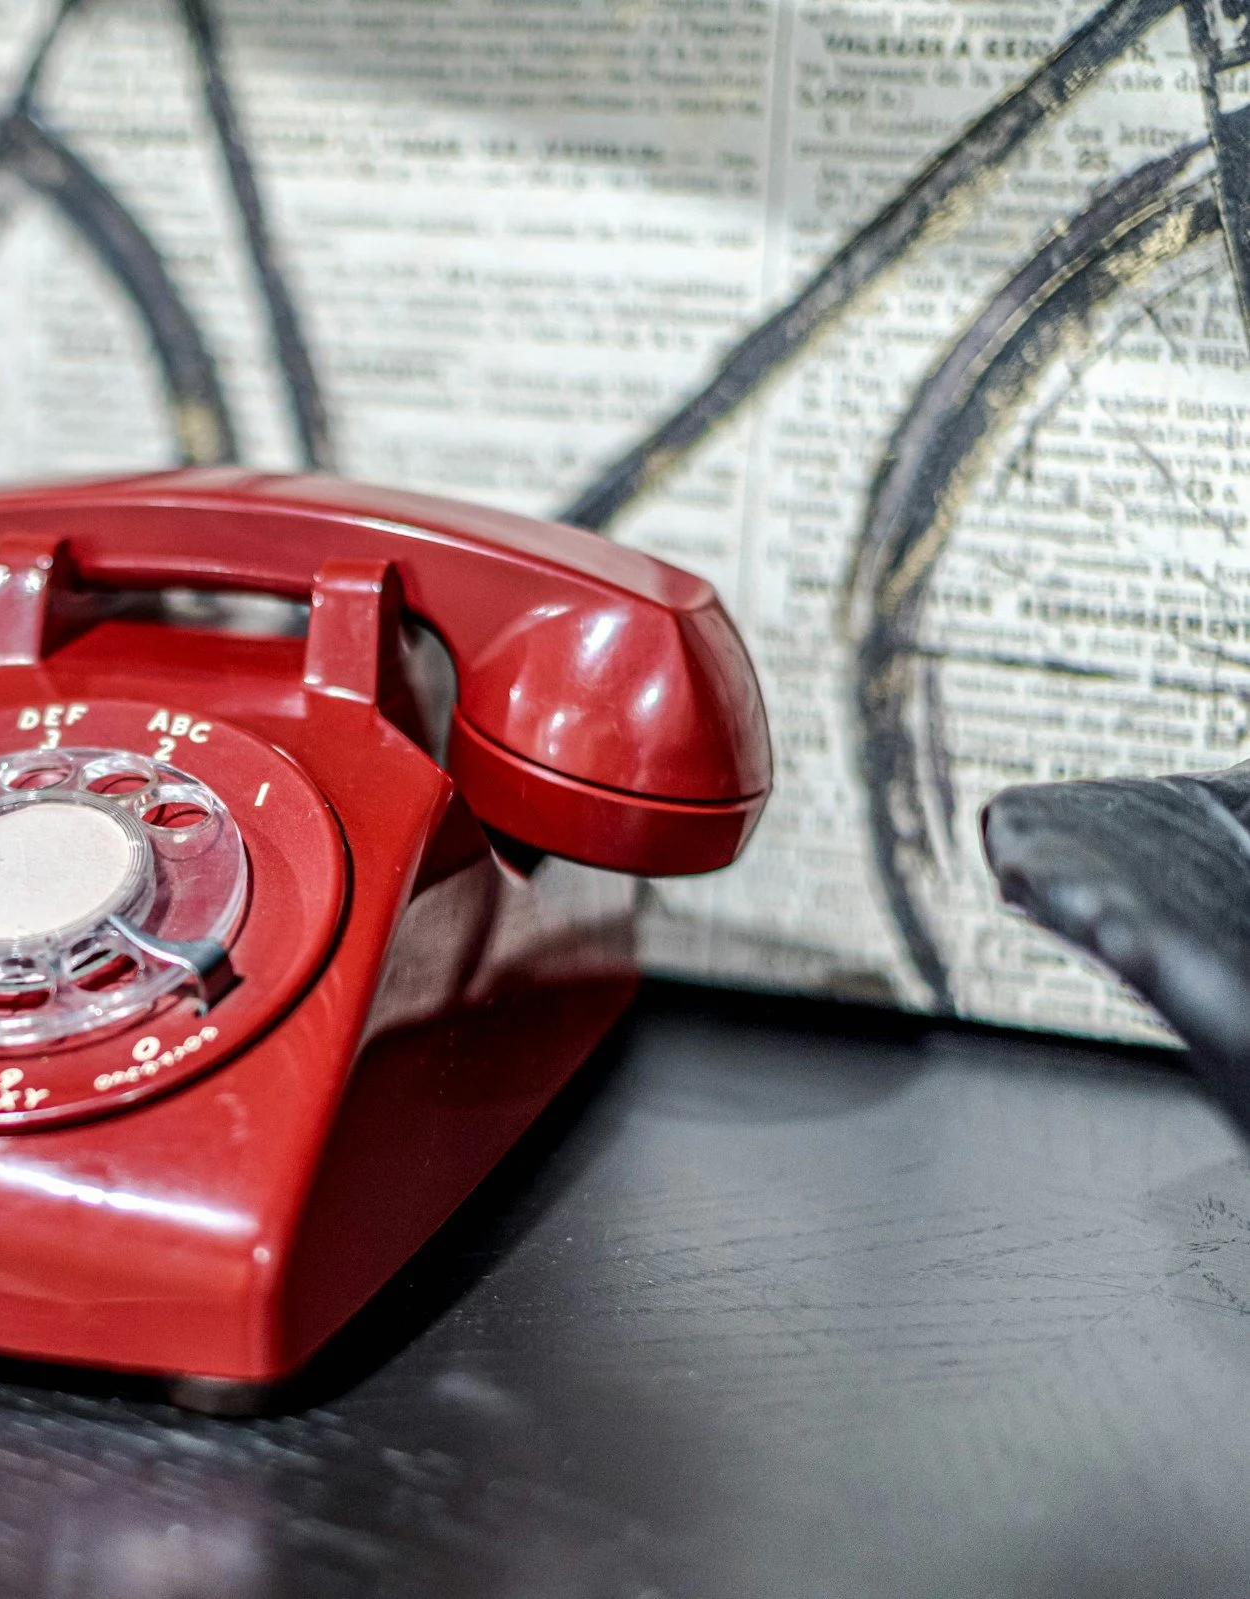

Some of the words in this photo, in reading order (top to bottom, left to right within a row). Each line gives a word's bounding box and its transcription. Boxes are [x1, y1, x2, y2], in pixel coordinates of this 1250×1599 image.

[17, 703, 88, 730] DEF
[147, 709, 212, 744] ABC
[40, 729, 61, 750] 3
[154, 737, 175, 761] 2
[254, 782, 270, 807] 1
